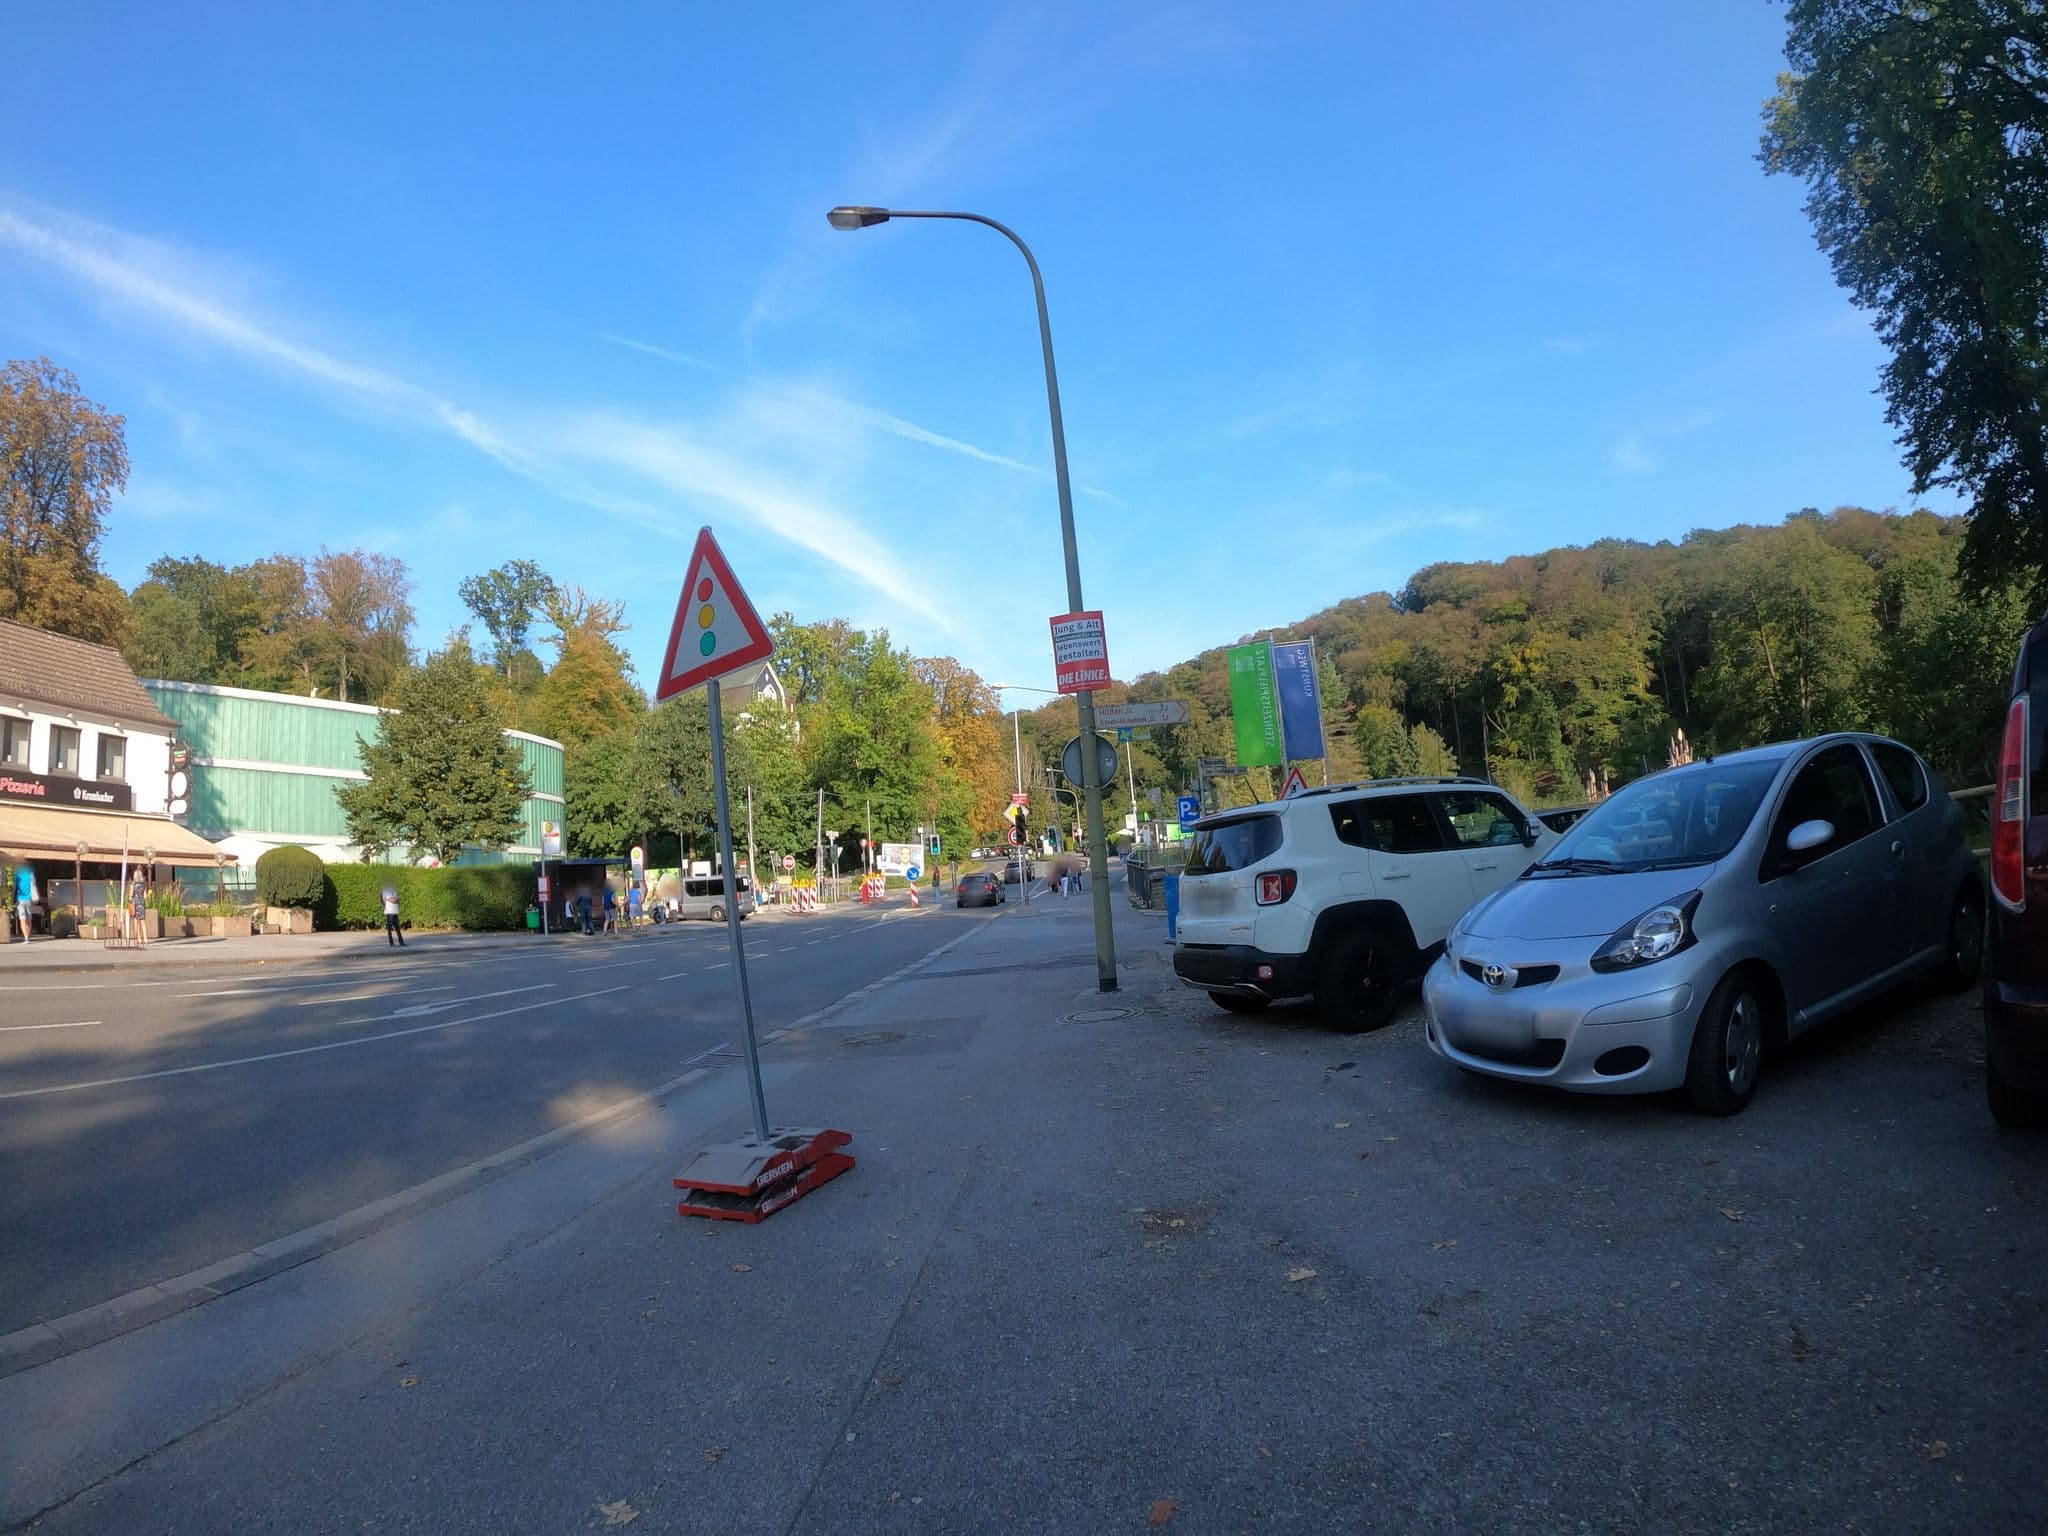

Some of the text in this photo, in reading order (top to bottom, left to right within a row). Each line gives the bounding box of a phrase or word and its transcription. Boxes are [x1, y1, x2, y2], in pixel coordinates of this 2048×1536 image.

[1054, 620, 1100, 635] Jung & Alt
[1056, 639, 1101, 651] lebenswert
[1058, 649, 1103, 662] gestalten.
[1059, 672, 1074, 686] DIE
[1099, 707, 1123, 717] Hilden
[0, 776, 45, 796] Pizzeria
[1179, 801, 1191, 818] P
[757, 1160, 793, 1185] GERKEN
